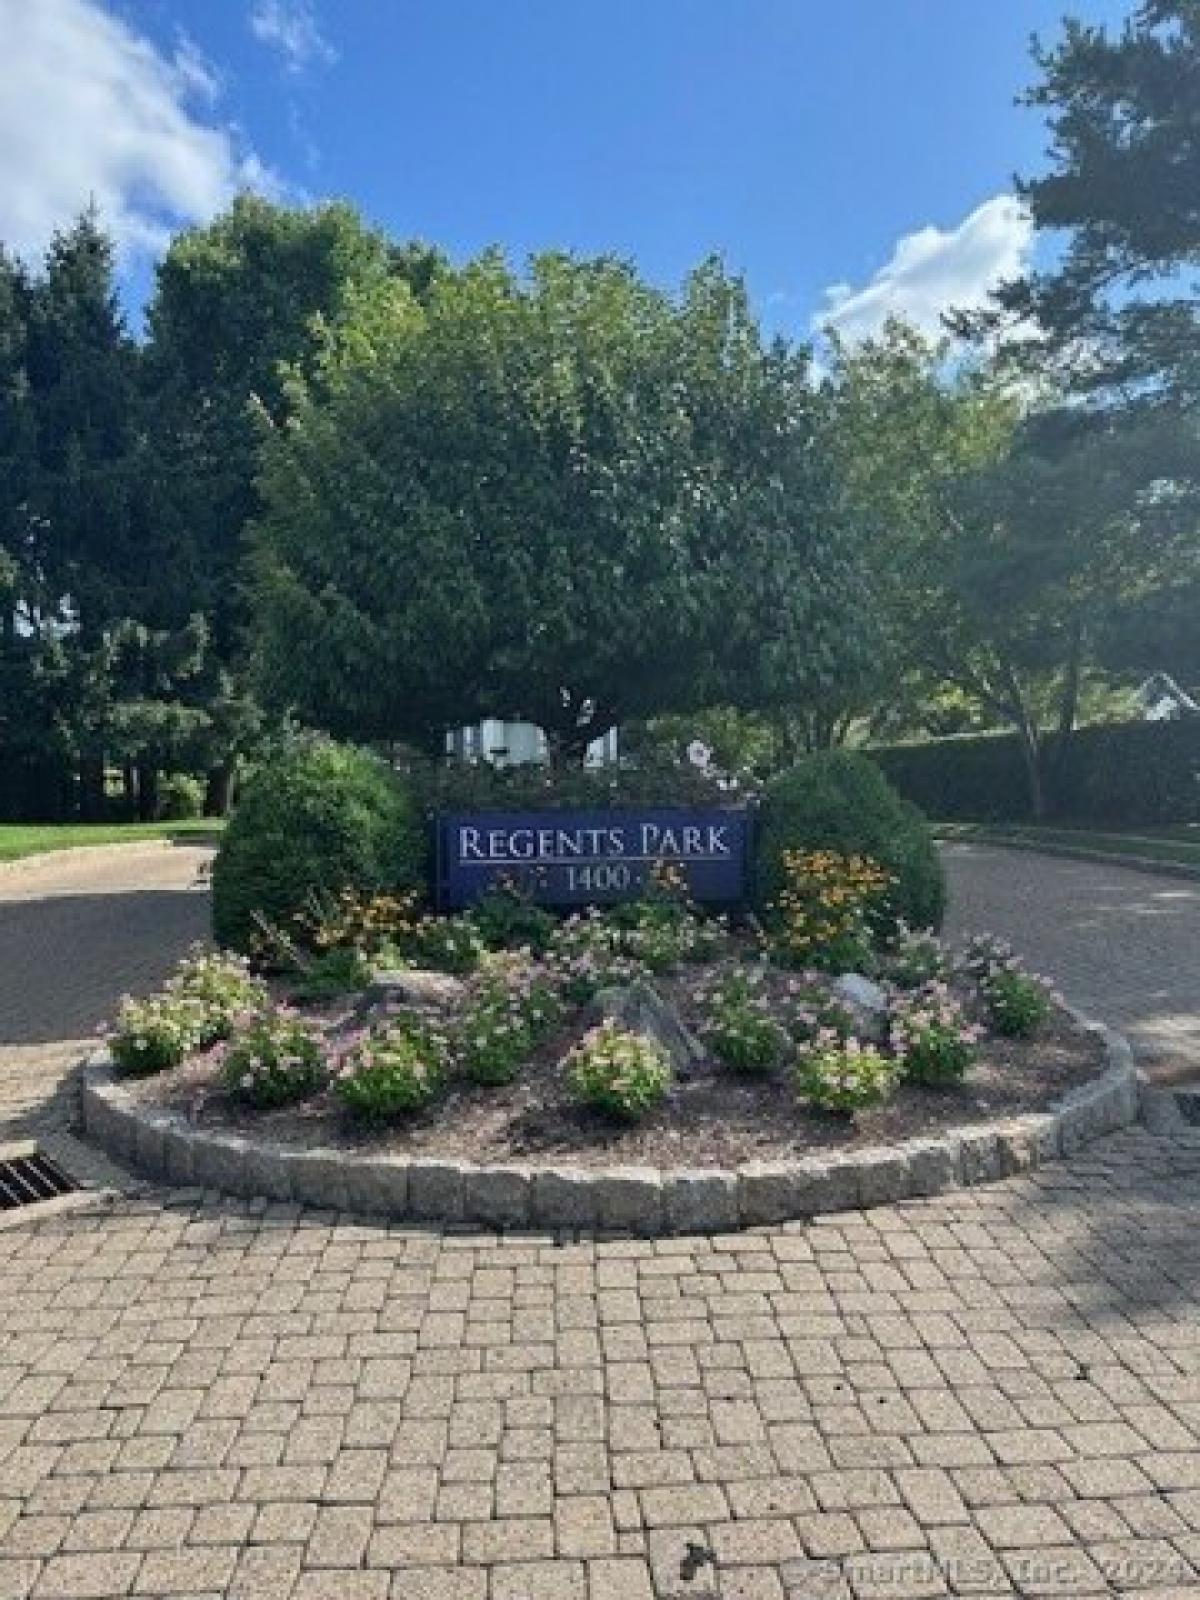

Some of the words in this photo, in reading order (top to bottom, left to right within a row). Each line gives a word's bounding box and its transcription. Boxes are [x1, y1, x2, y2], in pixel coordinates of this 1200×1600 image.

[459, 826, 624, 858] REGENTS
[640, 823, 730, 855] PARK
[567, 865, 631, 891] 1400
